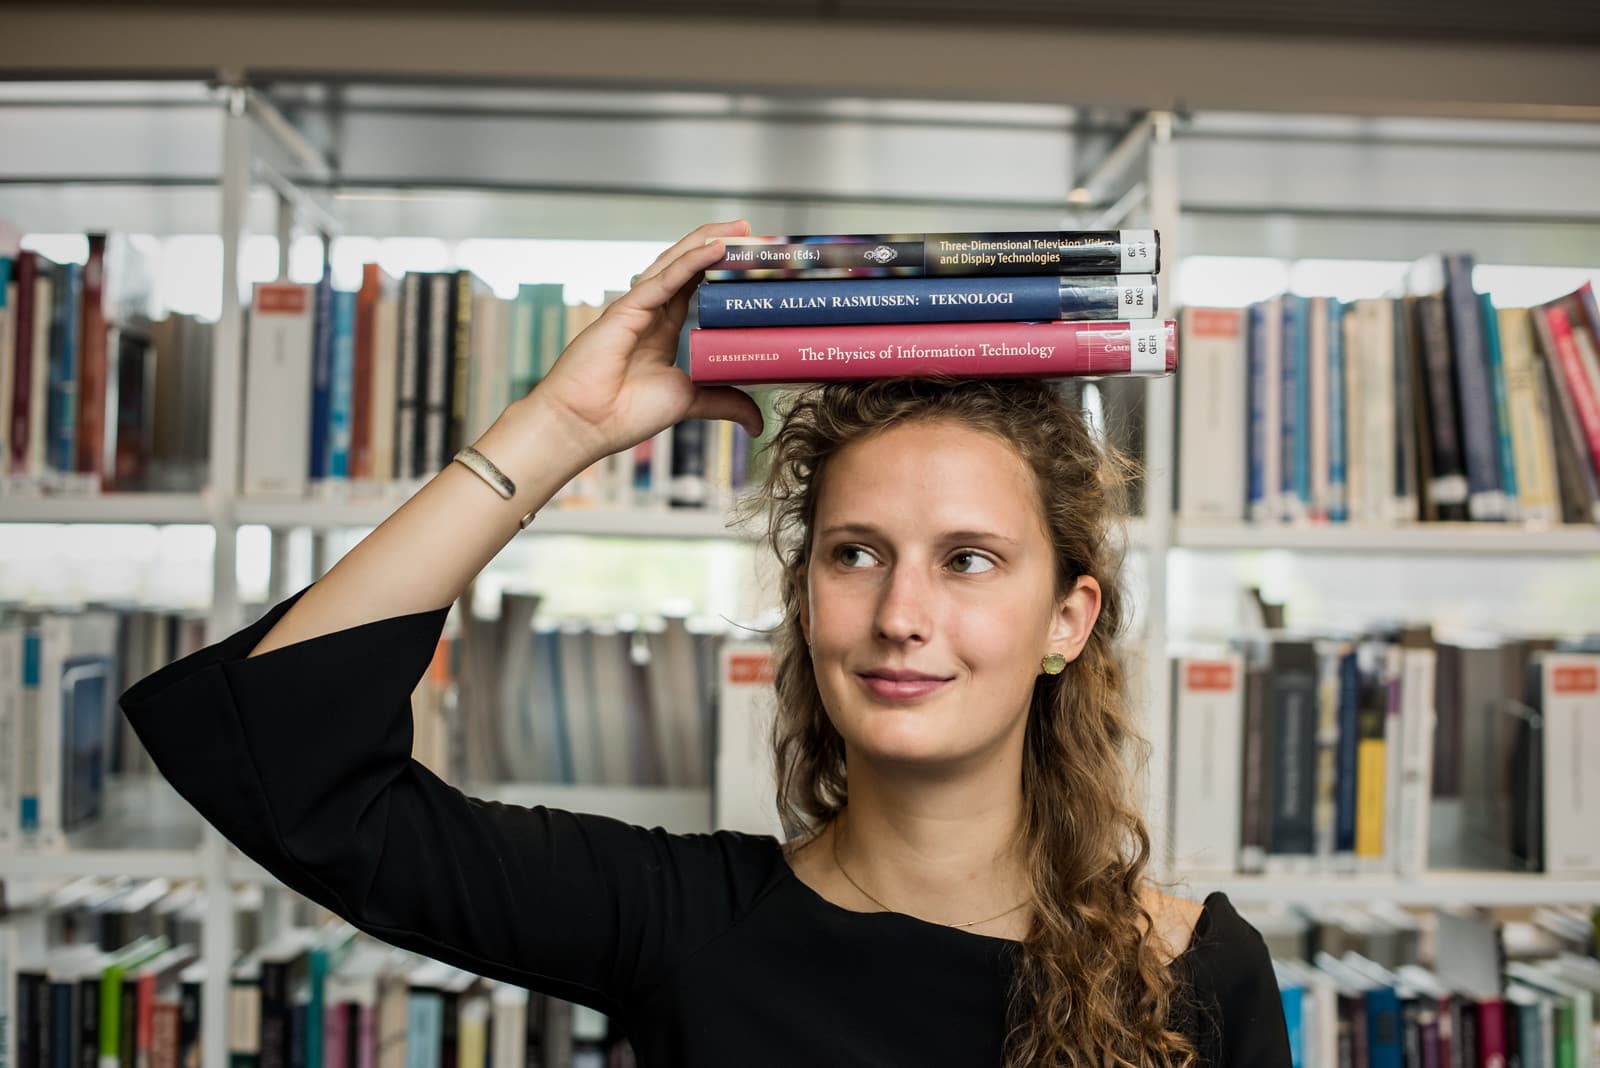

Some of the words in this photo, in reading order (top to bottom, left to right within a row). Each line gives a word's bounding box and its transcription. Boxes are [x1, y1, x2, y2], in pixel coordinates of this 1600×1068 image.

[940, 239, 1031, 251] Three-Dimensional
[725, 251, 754, 262] Javidi
[793, 249, 820, 261] (Eds.)
[940, 255, 959, 265] and
[961, 253, 996, 266] Display
[998, 252, 1061, 266] Technologies
[725, 299, 774, 310] FRANK
[780, 297, 826, 309] ALLAN
[832, 294, 920, 307] RASMUSSEN:
[929, 292, 1014, 305] TEKNOLOGI
[1125, 289, 1134, 305] 620
[1136, 287, 1144, 306] RAS
[708, 353, 780, 363] GERSHENFELD
[798, 347, 825, 361] The
[827, 345, 876, 363] Physics
[879, 345, 893, 359] of
[897, 344, 976, 359] Information
[979, 342, 1056, 358] Technology
[1138, 337, 1146, 353] 621
[1148, 334, 1157, 355] GER
